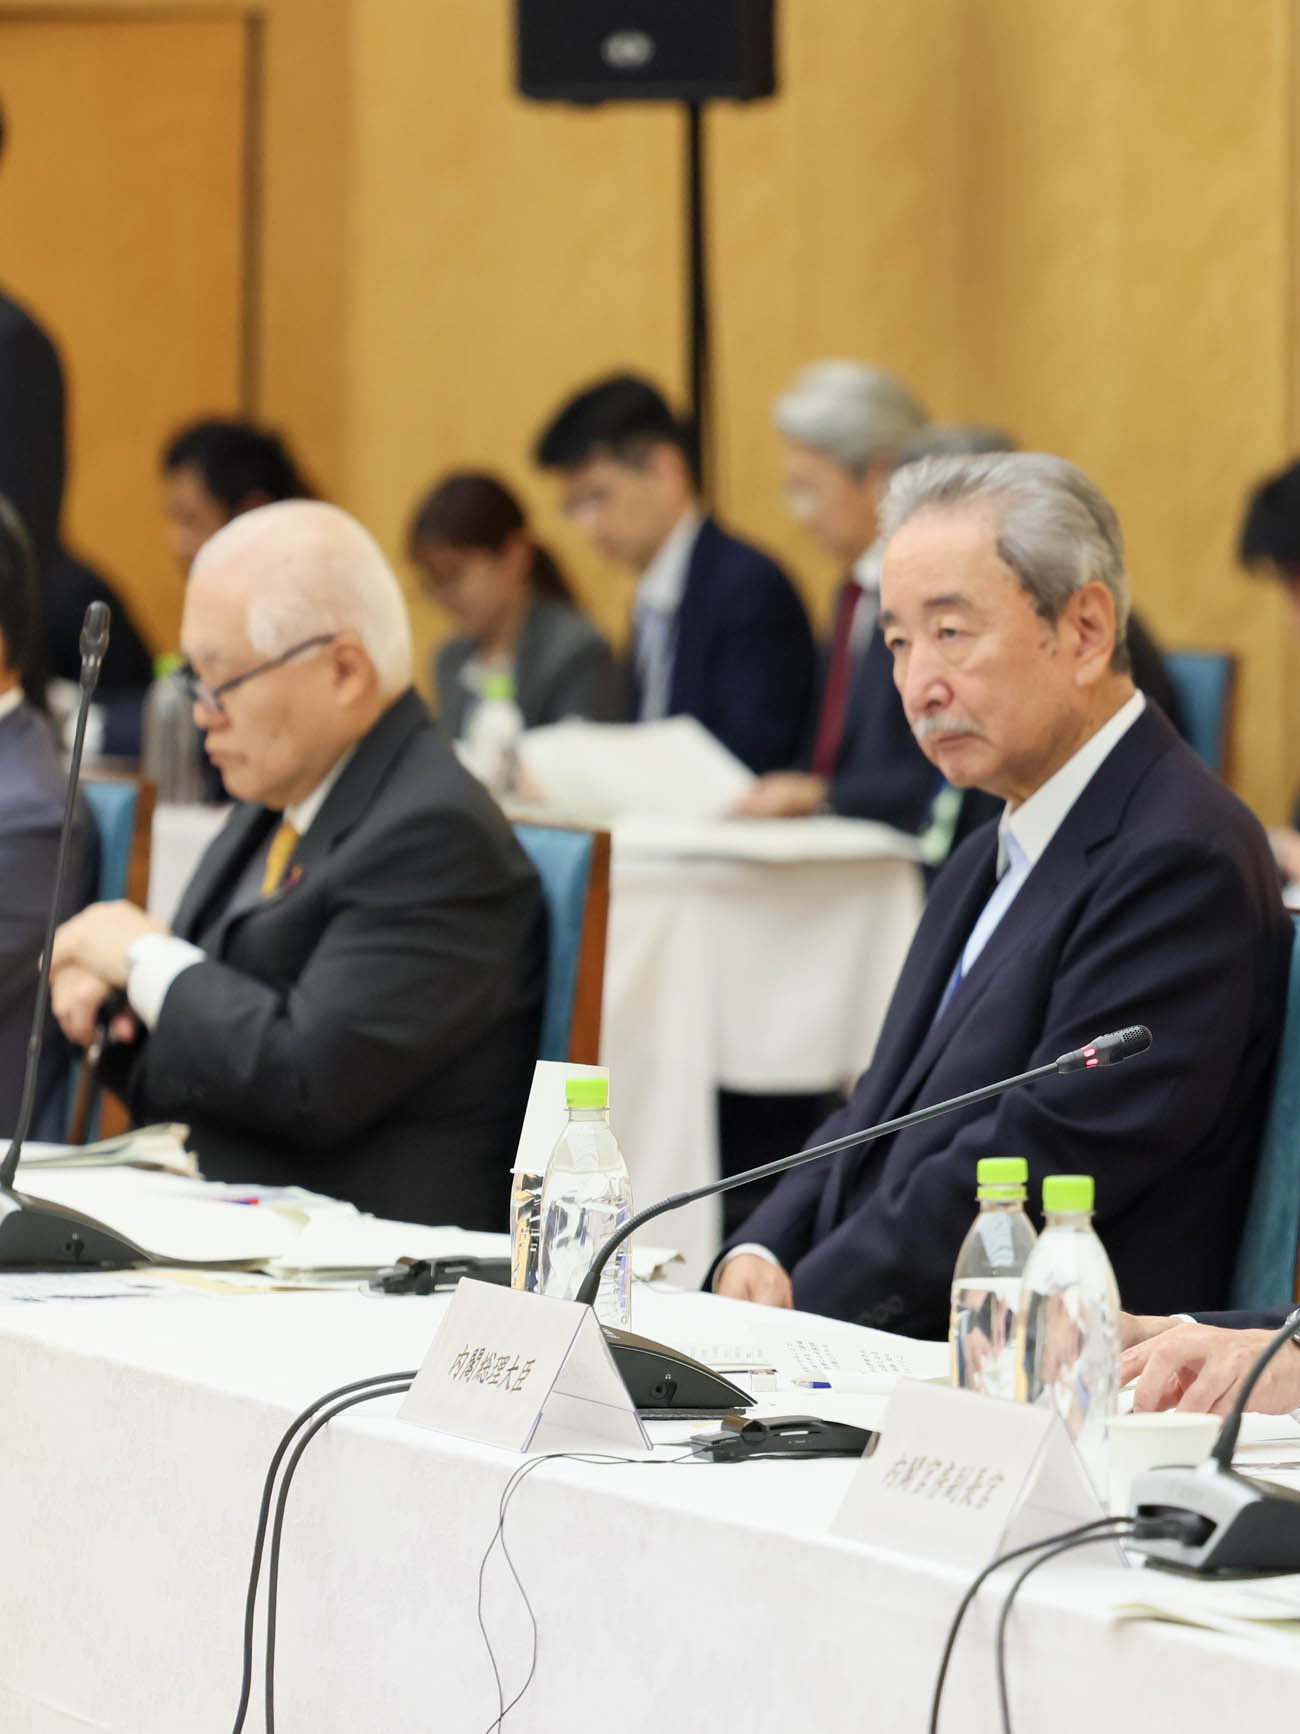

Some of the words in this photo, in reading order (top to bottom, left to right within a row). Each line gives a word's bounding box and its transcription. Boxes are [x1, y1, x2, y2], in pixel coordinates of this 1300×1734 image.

[447, 1344, 537, 1392] 内閣総理大臣
